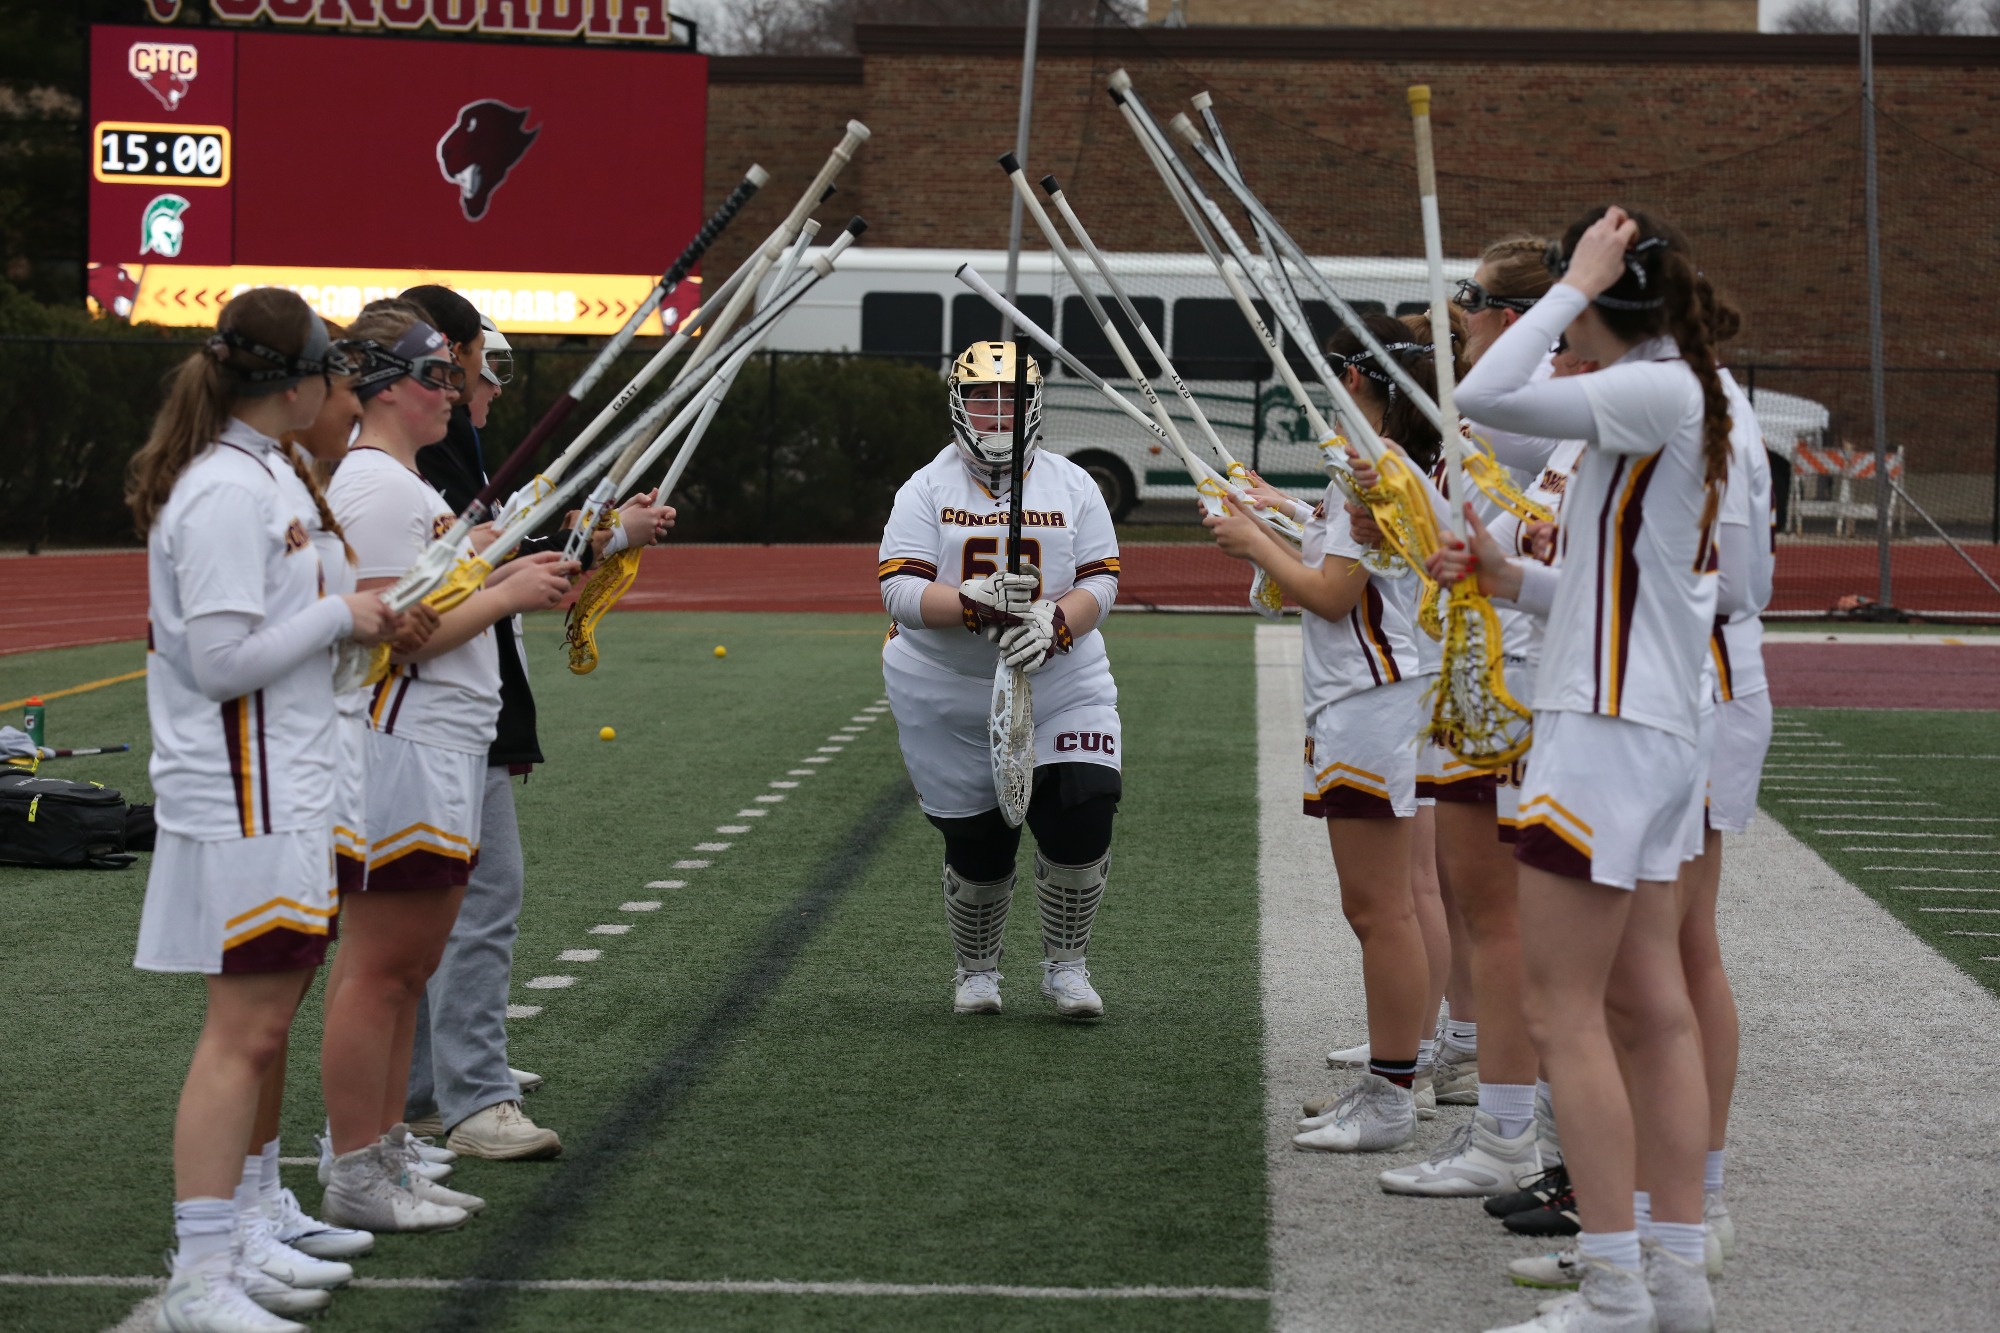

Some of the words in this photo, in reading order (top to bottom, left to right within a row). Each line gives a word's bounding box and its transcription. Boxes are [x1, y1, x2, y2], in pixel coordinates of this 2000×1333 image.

[102, 133, 222, 175] 15:00
[612, 383, 639, 412] GAIT
[1136, 377, 1158, 405] GAIT
[1171, 374, 1191, 399] GAIT
[1149, 423, 1167, 437] AIT
[1053, 731, 1116, 756] CUC
